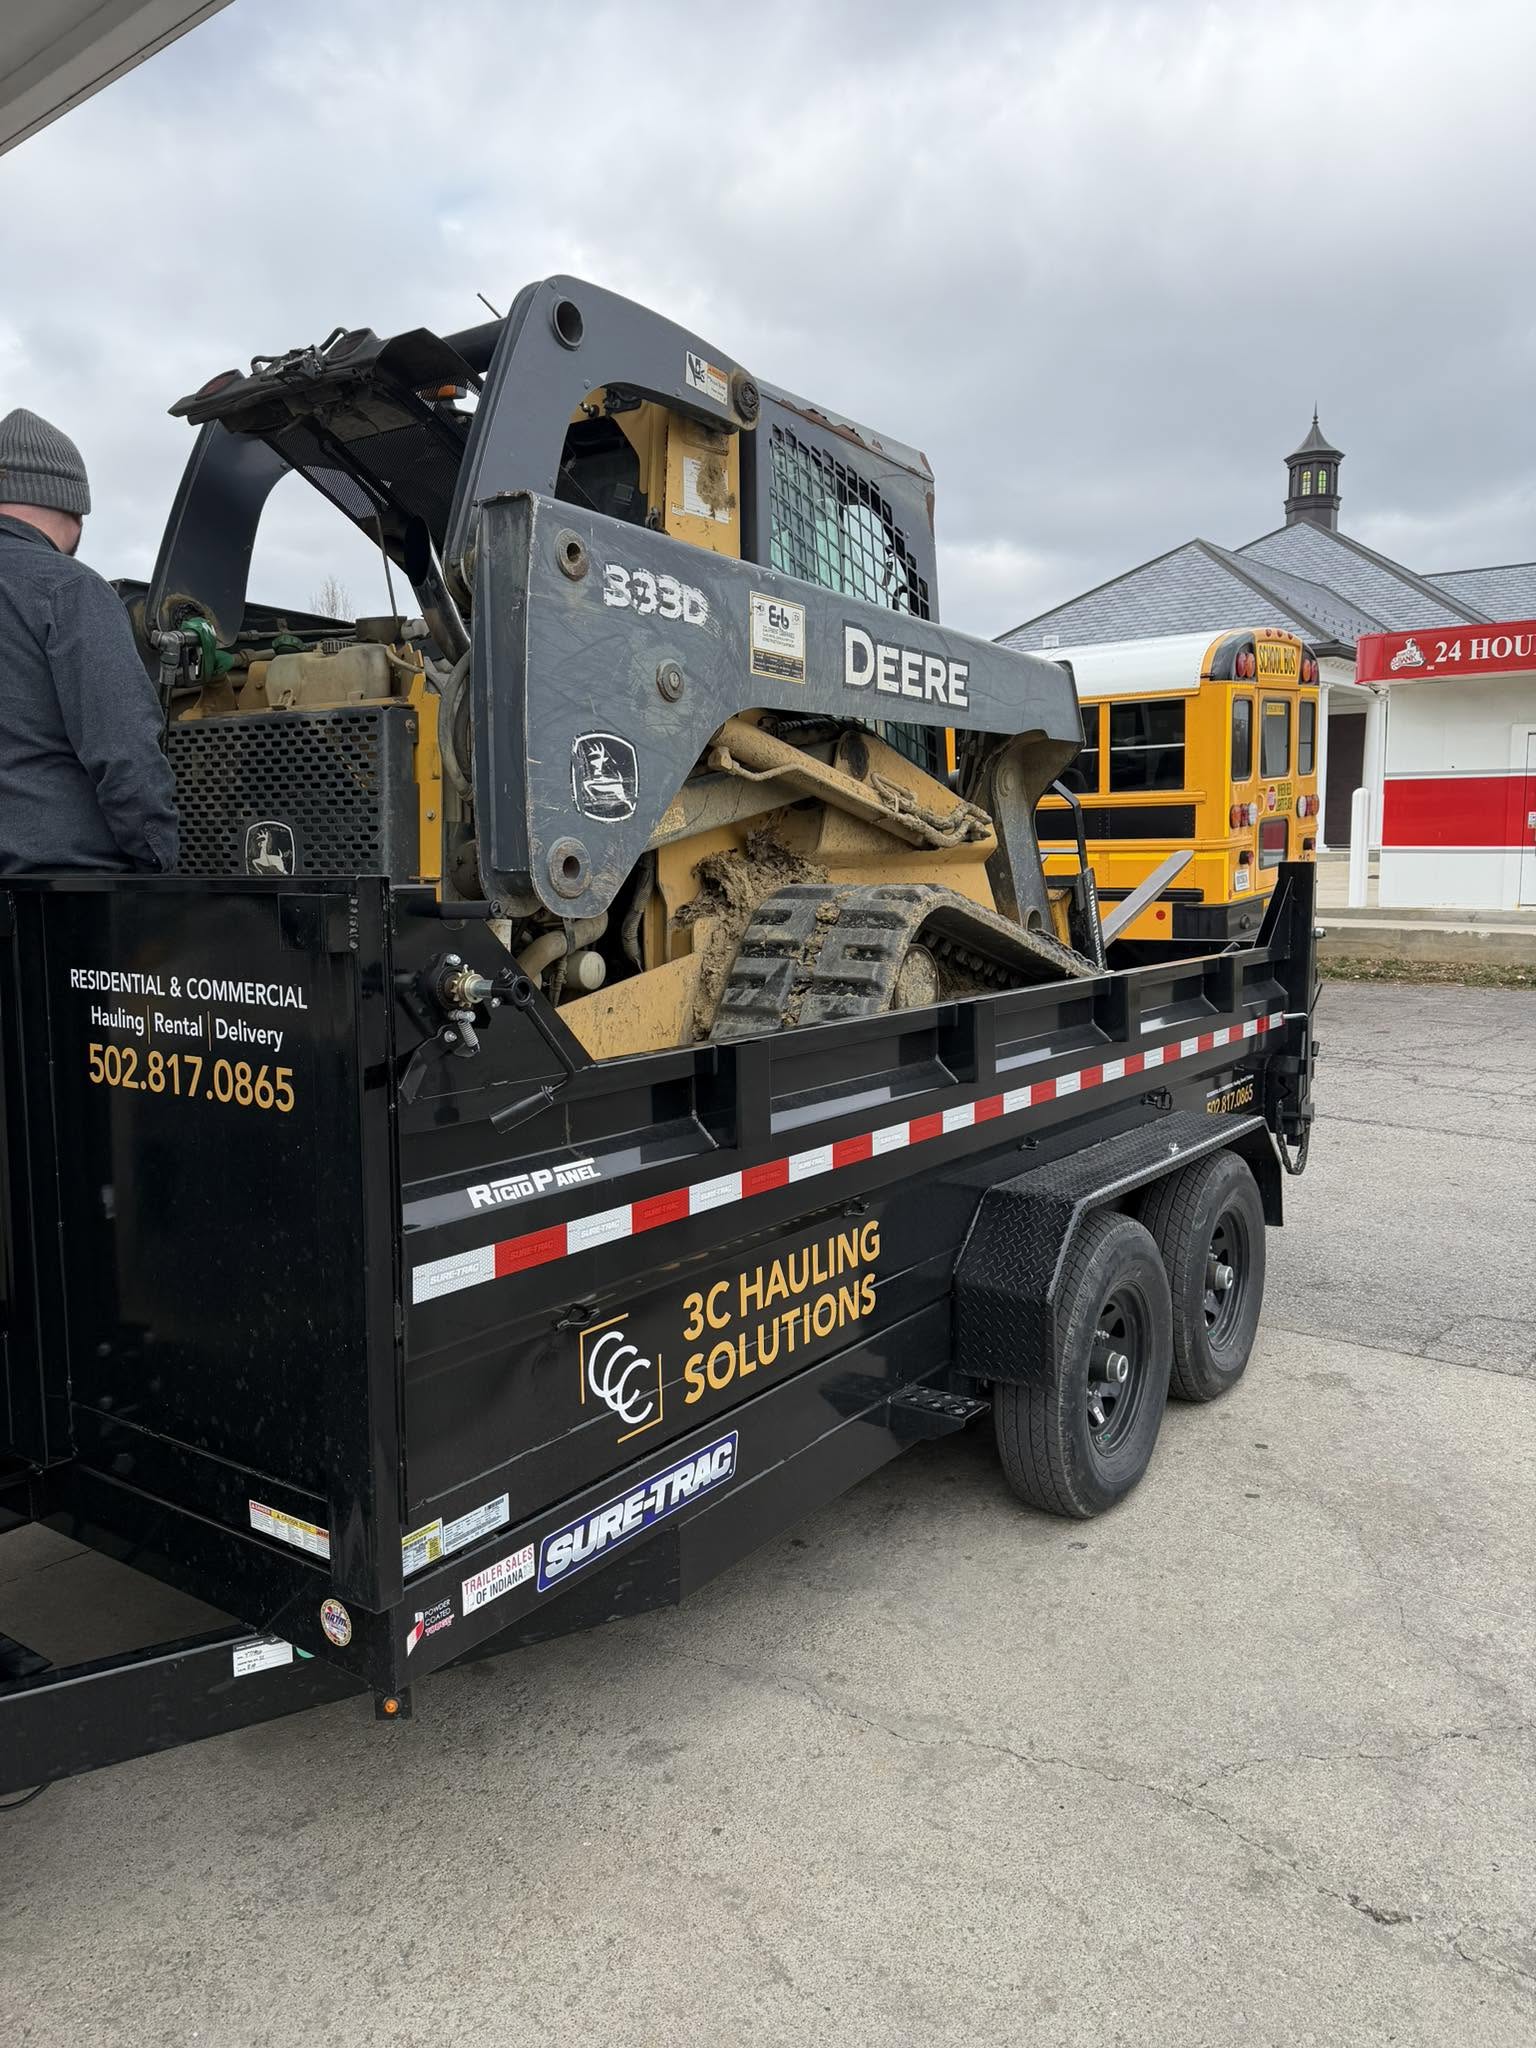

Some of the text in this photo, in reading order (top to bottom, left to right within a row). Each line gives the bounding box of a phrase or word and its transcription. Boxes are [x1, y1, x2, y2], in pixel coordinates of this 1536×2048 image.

[844, 626, 968, 707] DEERE
[1259, 644, 1296, 675] SCHOOL BUS
[1434, 634, 1536, 663] 24 HOU
[70, 968, 308, 1010] RESIDENTIAL & COMMERCIAL
[91, 1005, 283, 1053] Hauling Rental Delivery
[89, 1042, 295, 1113] 502.817.0865
[429, 1263, 480, 1286] SURE-TRAC
[682, 1220, 880, 1342] 3C HAULING
[684, 1273, 877, 1405] SOLUTIONS
[545, 1441, 733, 1578] SURE-TRAC
[464, 1564, 503, 1595] TRAILER
[505, 1547, 533, 1573] SALES
[476, 1587, 487, 1605] OF
[489, 1568, 524, 1598] INDIANA
[424, 1599, 450, 1619] POWDER
[424, 1608, 451, 1627] COATED
